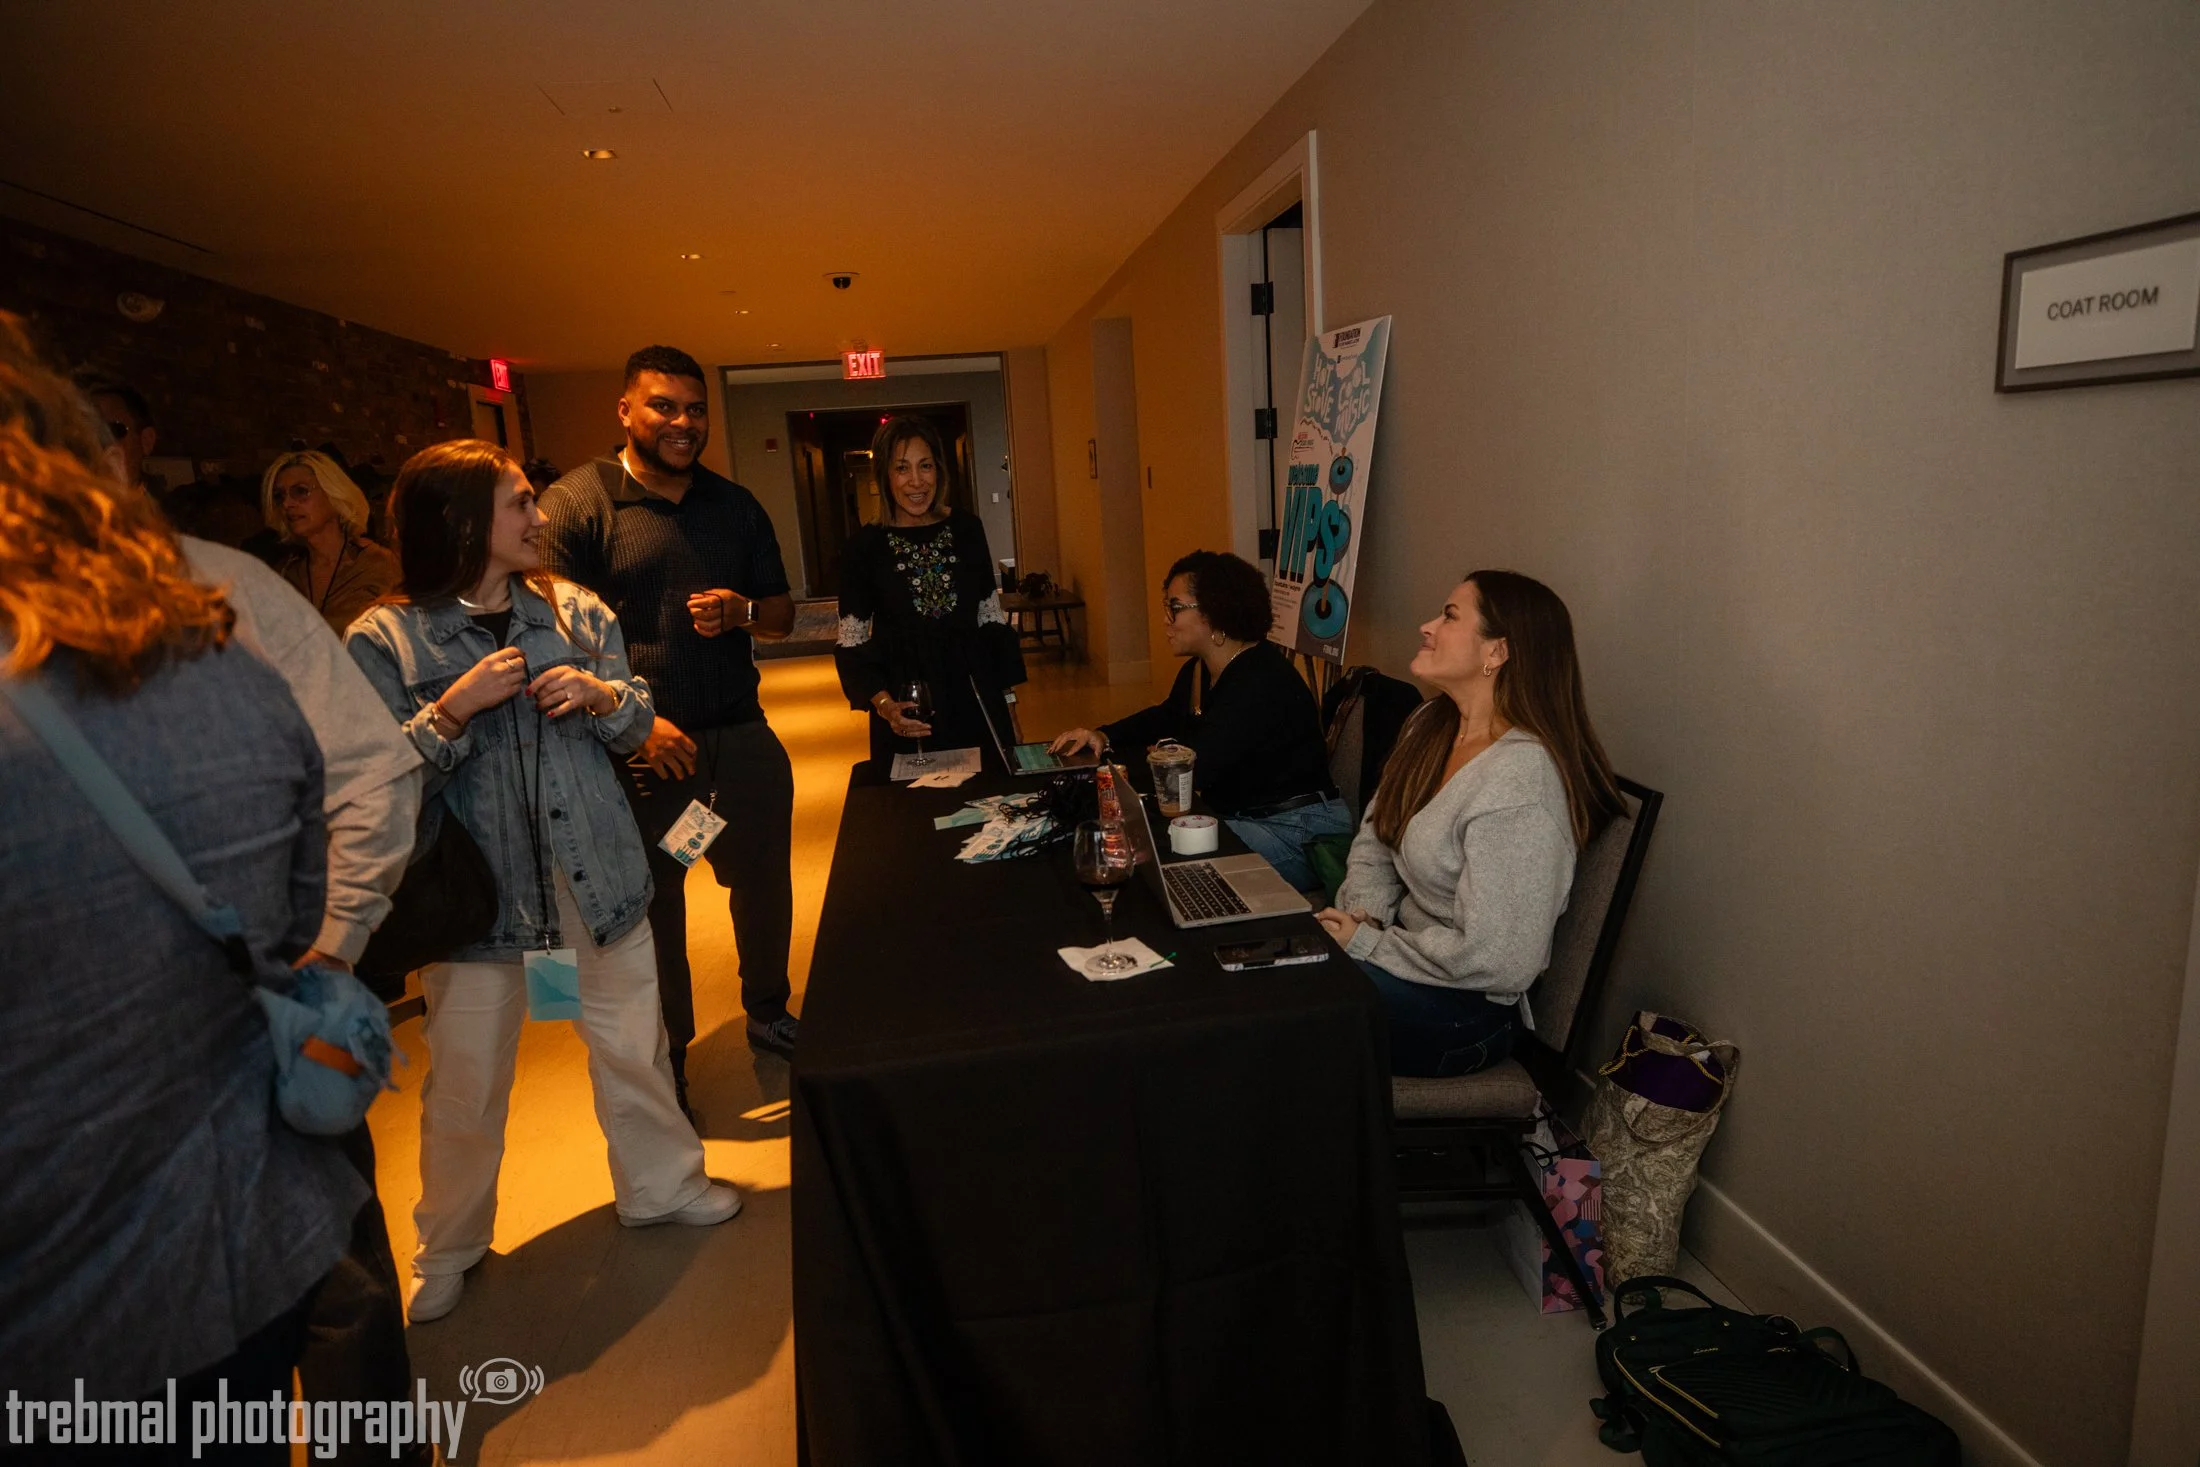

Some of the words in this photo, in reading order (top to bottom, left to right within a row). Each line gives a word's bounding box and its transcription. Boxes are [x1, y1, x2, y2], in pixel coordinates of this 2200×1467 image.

[2047, 296, 2094, 321] COAT
[2098, 286, 2160, 313] ROOM
[847, 352, 881, 377] EXIT
[1313, 352, 1335, 390] HOT
[1338, 361, 1371, 411] COOL
[1278, 486, 1341, 589] VIPS
